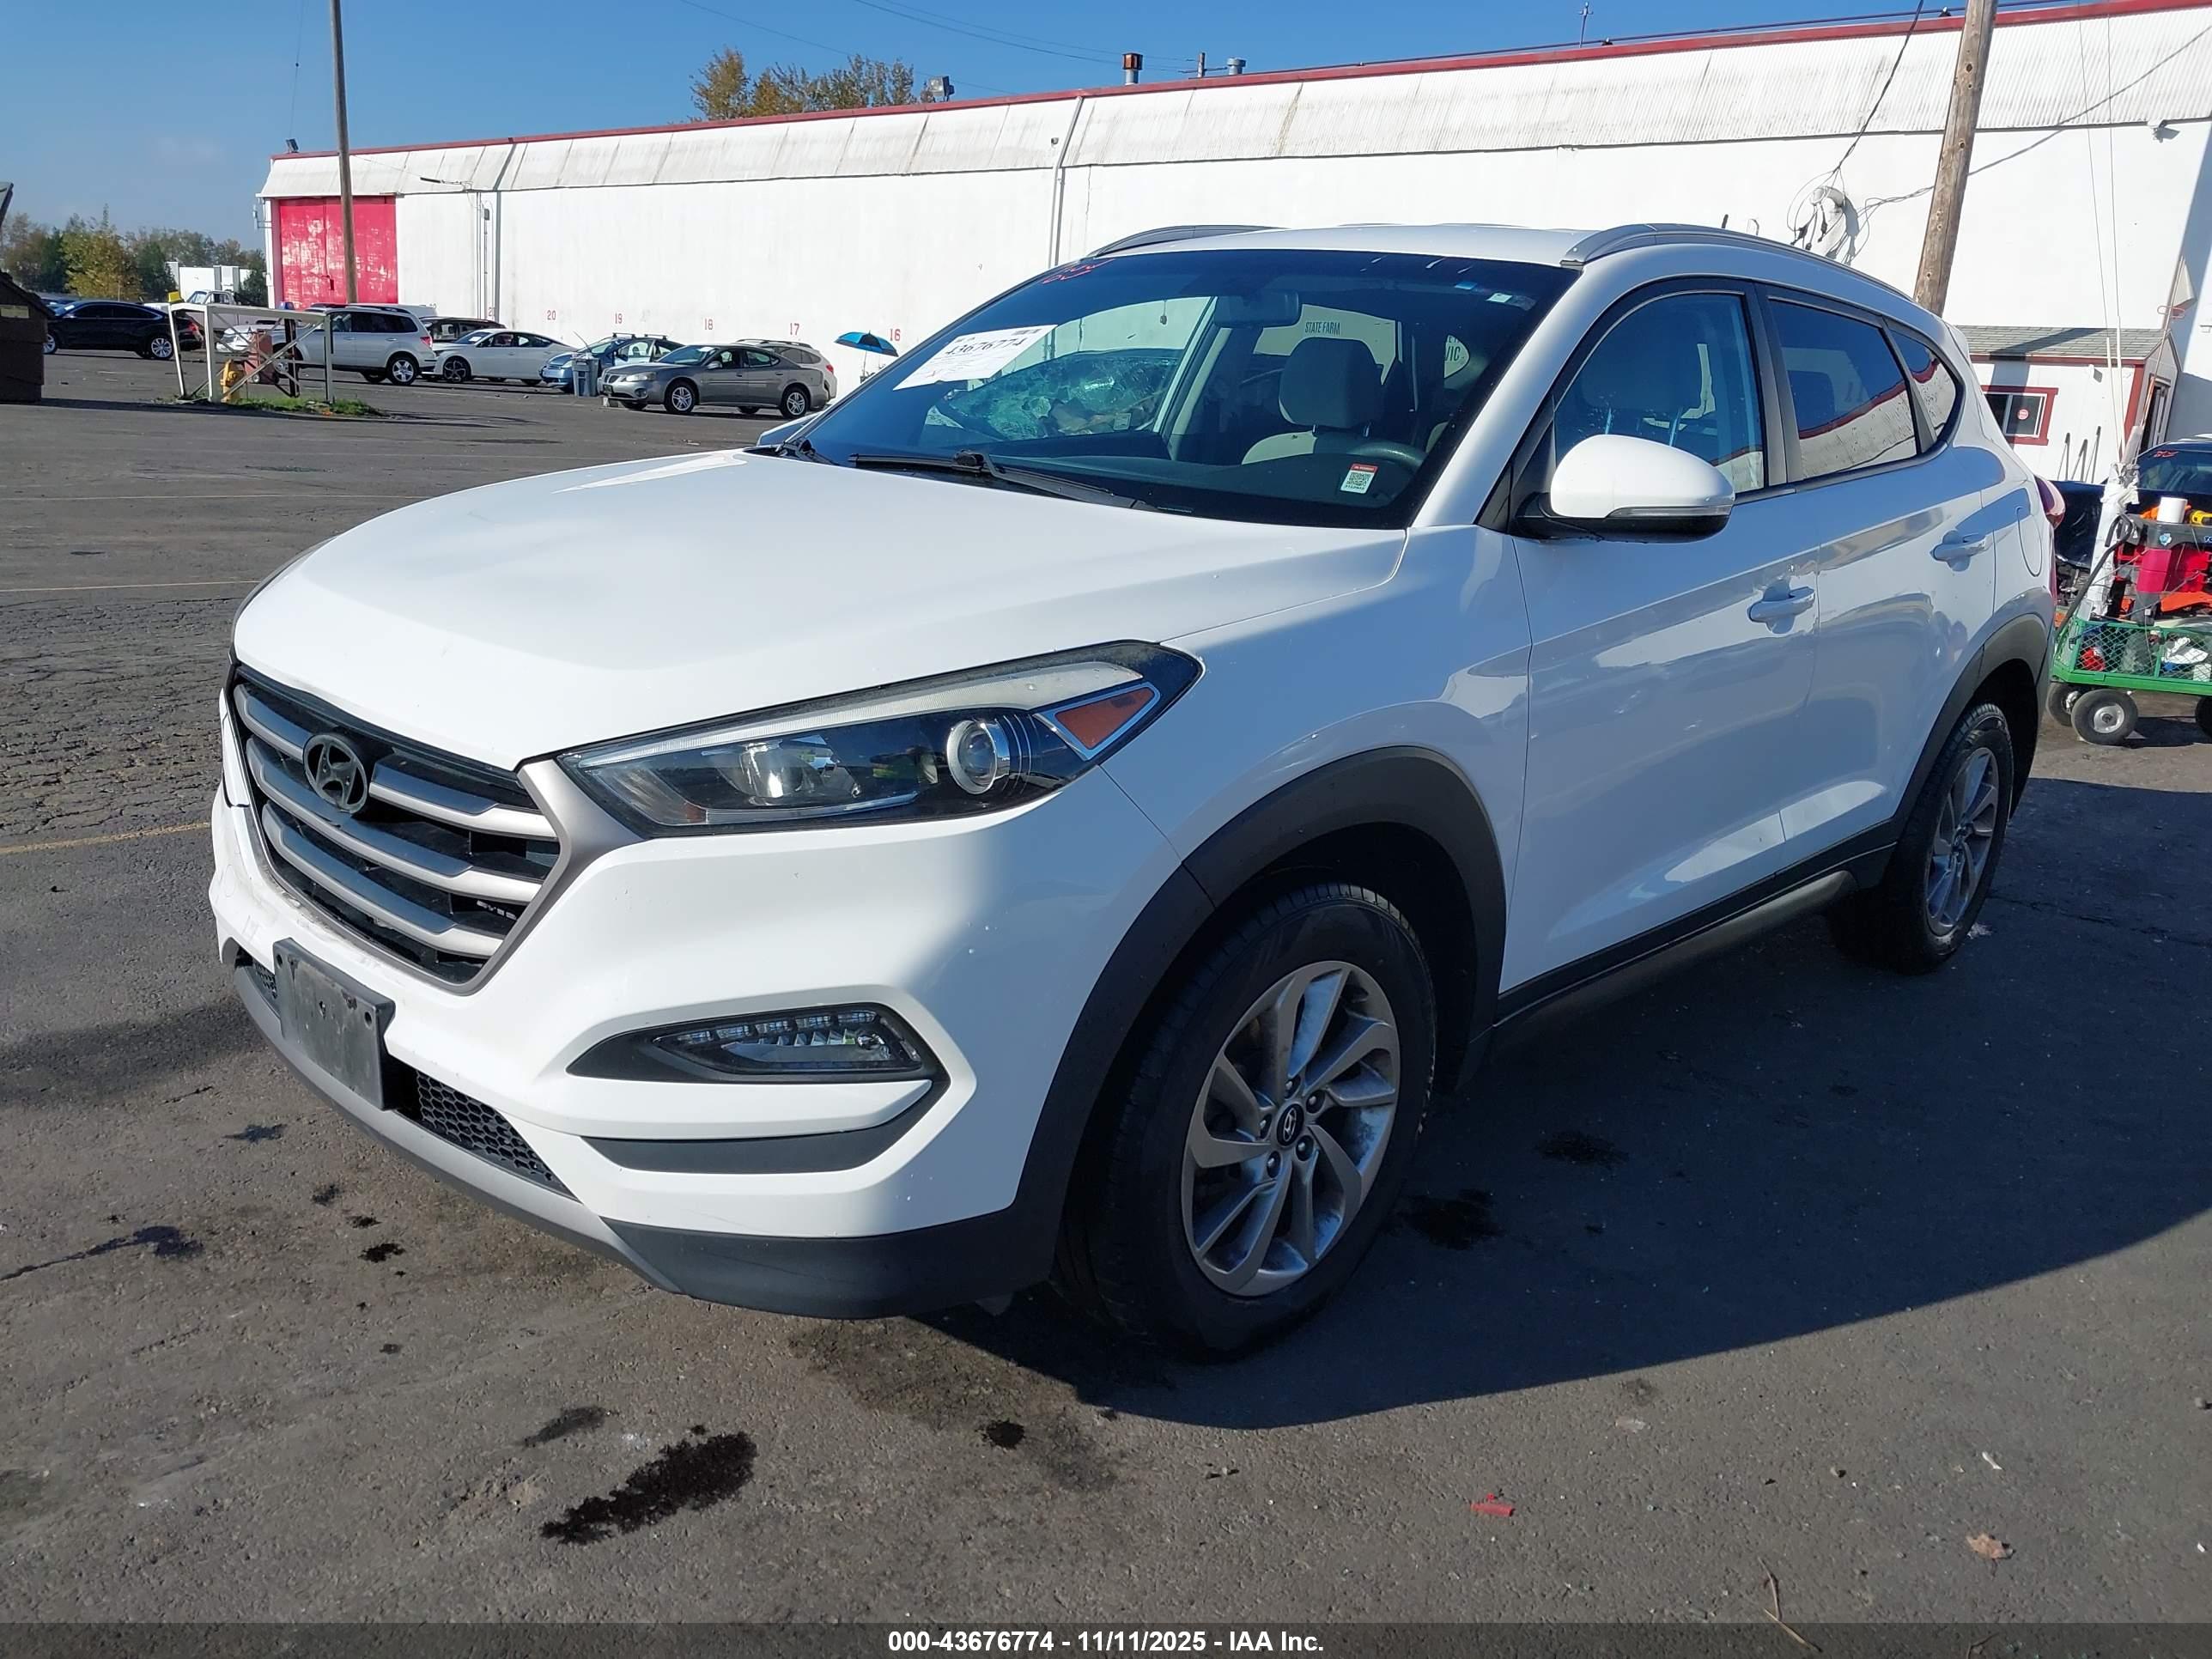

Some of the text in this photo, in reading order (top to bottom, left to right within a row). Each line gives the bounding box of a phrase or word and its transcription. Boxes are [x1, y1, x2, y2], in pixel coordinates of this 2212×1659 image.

[546, 310, 556, 320] 20
[615, 313, 623, 324] 19
[704, 319, 714, 331] 18
[790, 323, 799, 336] 17
[1304, 321, 1340, 336] STATE FARM
[890, 328, 901, 342] 16
[945, 337, 1027, 355] 43676774
